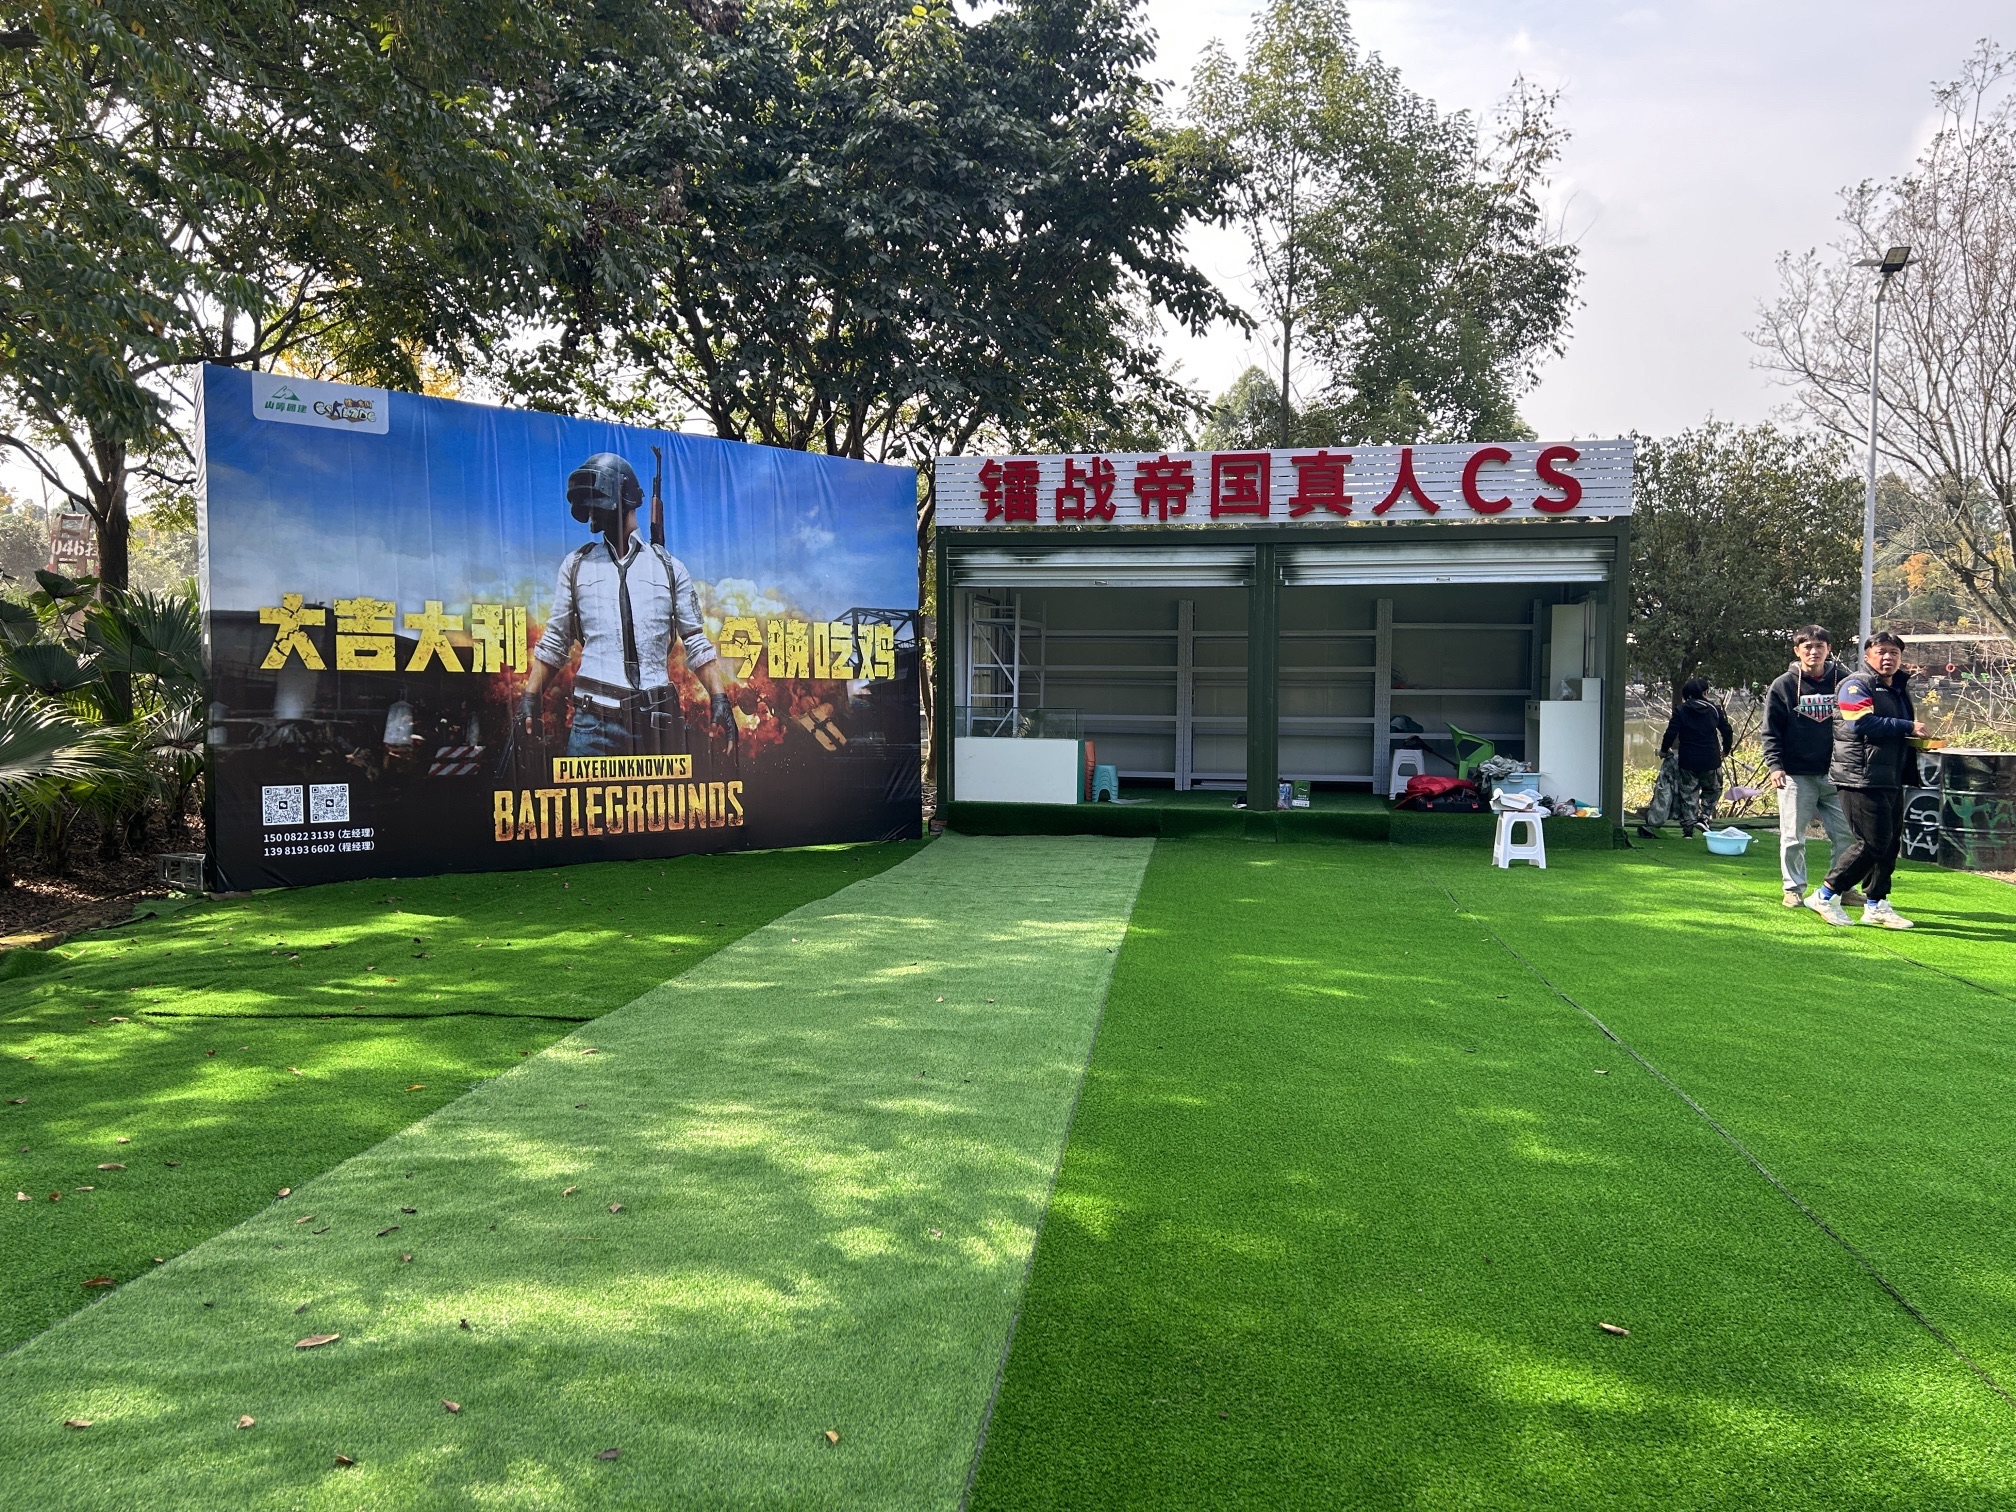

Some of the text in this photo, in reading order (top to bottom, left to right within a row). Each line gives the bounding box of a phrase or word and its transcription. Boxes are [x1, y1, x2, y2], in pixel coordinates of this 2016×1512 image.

[978, 445, 1583, 522] 镭战帝国真人CS
[259, 593, 896, 680] 大吉大利 今晚吃鸡
[559, 758, 687, 779] PLAYERUNKNOWN'S
[493, 781, 744, 842] BATTLEGROUNDS
[263, 833, 282, 843] 150
[284, 832, 309, 842] 0822
[311, 830, 335, 840] 3139
[264, 847, 283, 857] 139
[284, 845, 309, 855] 8193
[311, 843, 335, 854] 6602
